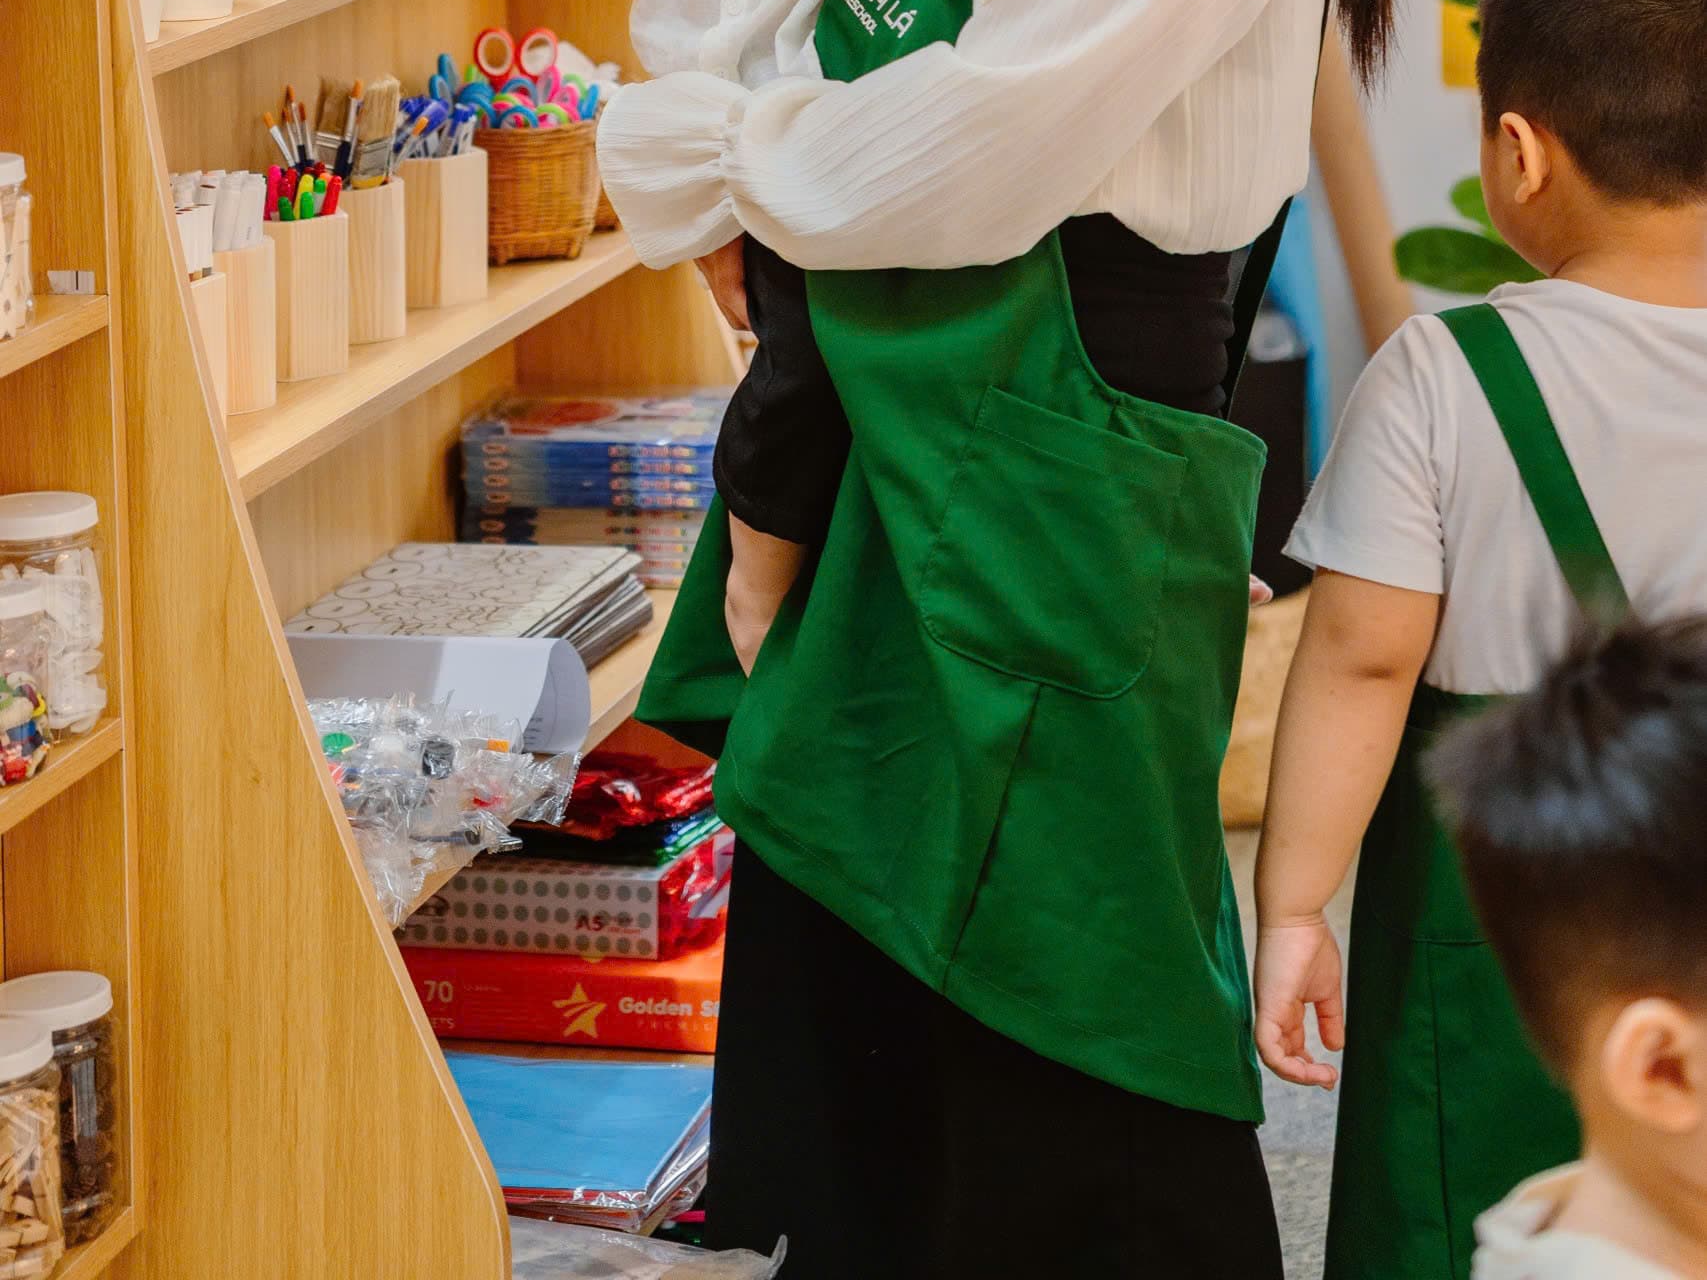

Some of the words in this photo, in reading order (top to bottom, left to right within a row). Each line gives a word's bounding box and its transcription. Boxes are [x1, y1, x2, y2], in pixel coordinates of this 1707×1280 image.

[575, 912, 605, 932] A5
[423, 980, 454, 1003] 70
[618, 996, 693, 1016] Golden
